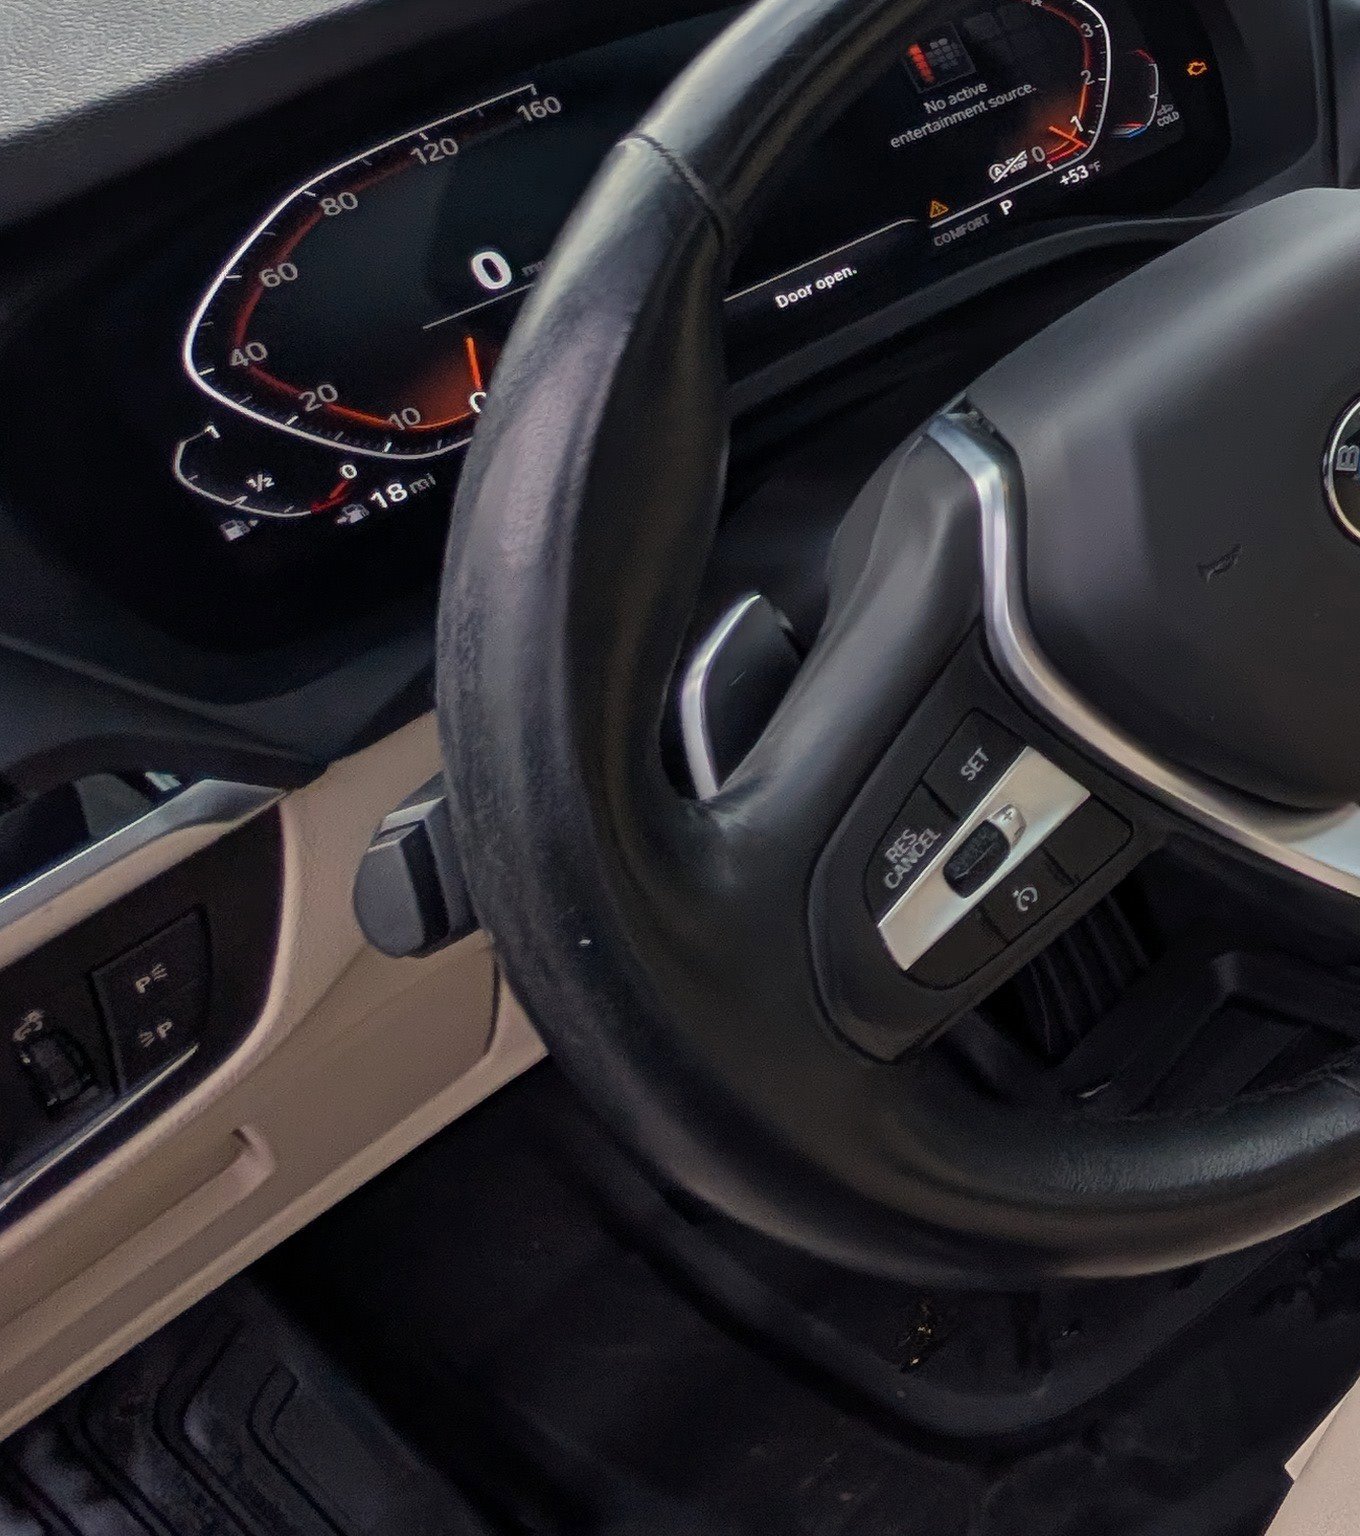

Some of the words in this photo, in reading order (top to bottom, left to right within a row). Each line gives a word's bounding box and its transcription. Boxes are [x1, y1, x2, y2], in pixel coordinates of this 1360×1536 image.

[1080, 22, 1094, 38] 3
[1080, 69, 1095, 85] 2
[516, 95, 562, 123] 160
[923, 95, 946, 115] No
[947, 80, 989, 107] active
[889, 99, 986, 150] entertainment
[987, 81, 1038, 110] source.
[1069, 114, 1084, 133] 1
[1156, 111, 1180, 128] COLD
[409, 137, 460, 166] 120
[1030, 145, 1046, 164] 0
[319, 190, 359, 217] 80
[1000, 199, 1013, 216] P
[932, 213, 991, 248] COMFORT
[258, 262, 299, 289] 60
[471, 250, 513, 290] 0
[775, 281, 813, 309] Door
[814, 264, 858, 293] open.
[228, 340, 268, 369] 40
[299, 382, 339, 414] 20
[205, 425, 221, 440] 1
[387, 406, 422, 433] 10
[339, 463, 358, 480] 0
[369, 482, 410, 511] 18
[407, 472, 438, 497] mi
[960, 747, 990, 782] SET
[883, 828, 942, 890] CANCEL
[884, 828, 919, 863] RES
